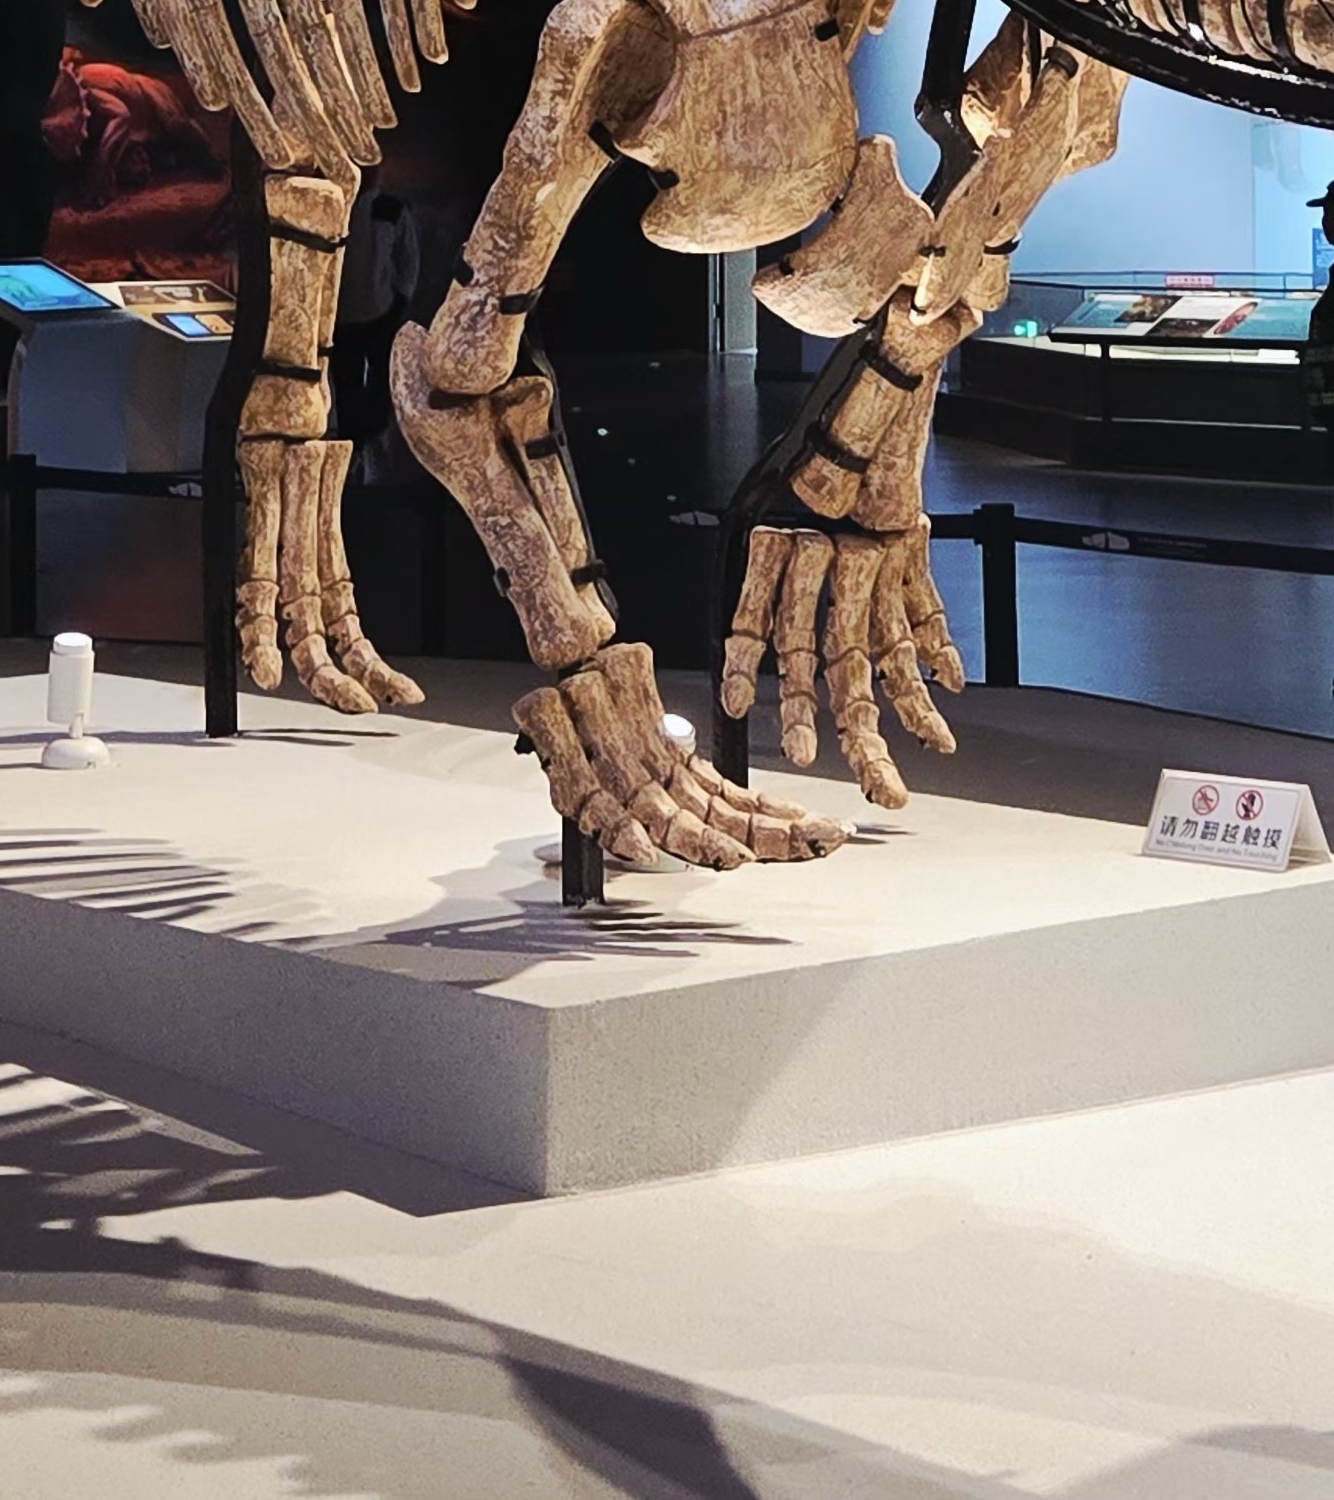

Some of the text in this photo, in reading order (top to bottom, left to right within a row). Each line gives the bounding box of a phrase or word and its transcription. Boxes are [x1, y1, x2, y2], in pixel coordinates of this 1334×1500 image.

[1160, 815, 1283, 850] 请勿翻越触摸
